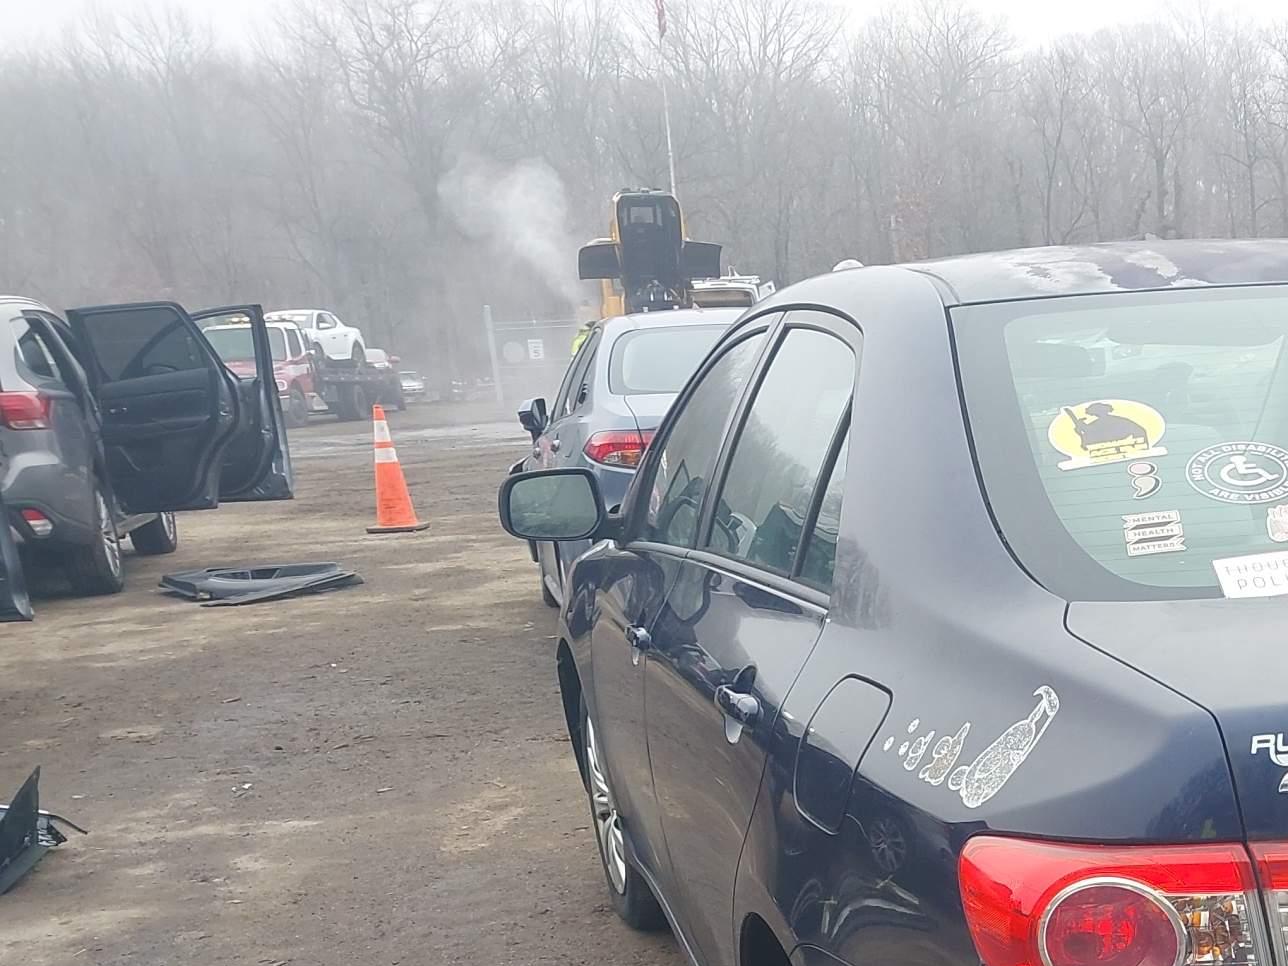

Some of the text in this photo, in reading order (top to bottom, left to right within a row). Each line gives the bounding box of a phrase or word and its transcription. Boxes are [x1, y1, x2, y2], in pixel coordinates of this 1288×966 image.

[1209, 488, 1240, 500] ARE
[1132, 514, 1173, 523] MENTAL
[1133, 528, 1174, 536] HEALTH
[1132, 542, 1175, 551] MATTERS
